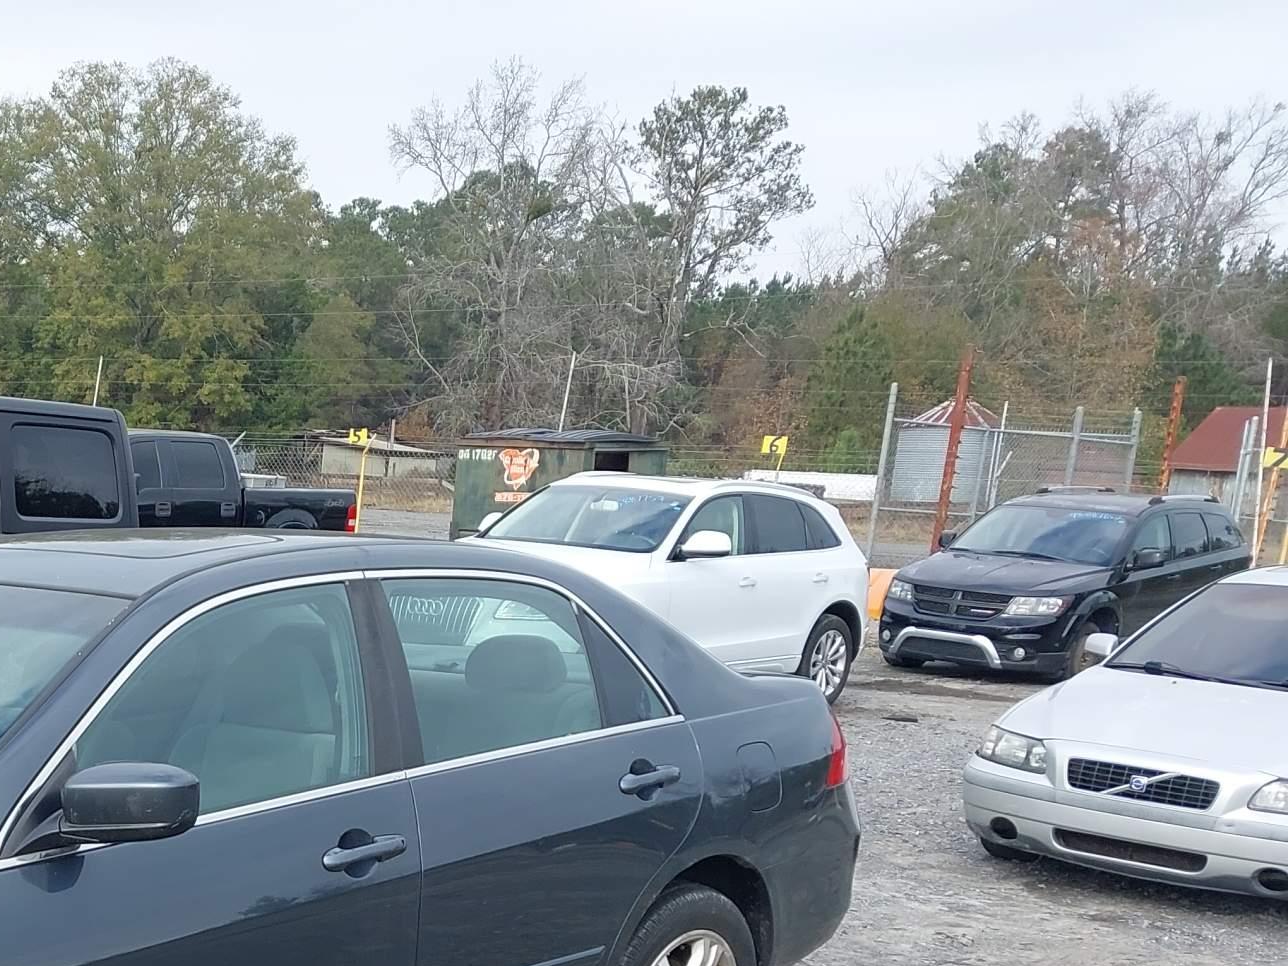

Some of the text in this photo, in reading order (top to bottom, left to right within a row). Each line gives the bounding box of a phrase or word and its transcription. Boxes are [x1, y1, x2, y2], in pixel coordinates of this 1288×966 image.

[352, 429, 362, 444] 5
[769, 436, 781, 453] 6
[1272, 447, 1288, 468] 7
